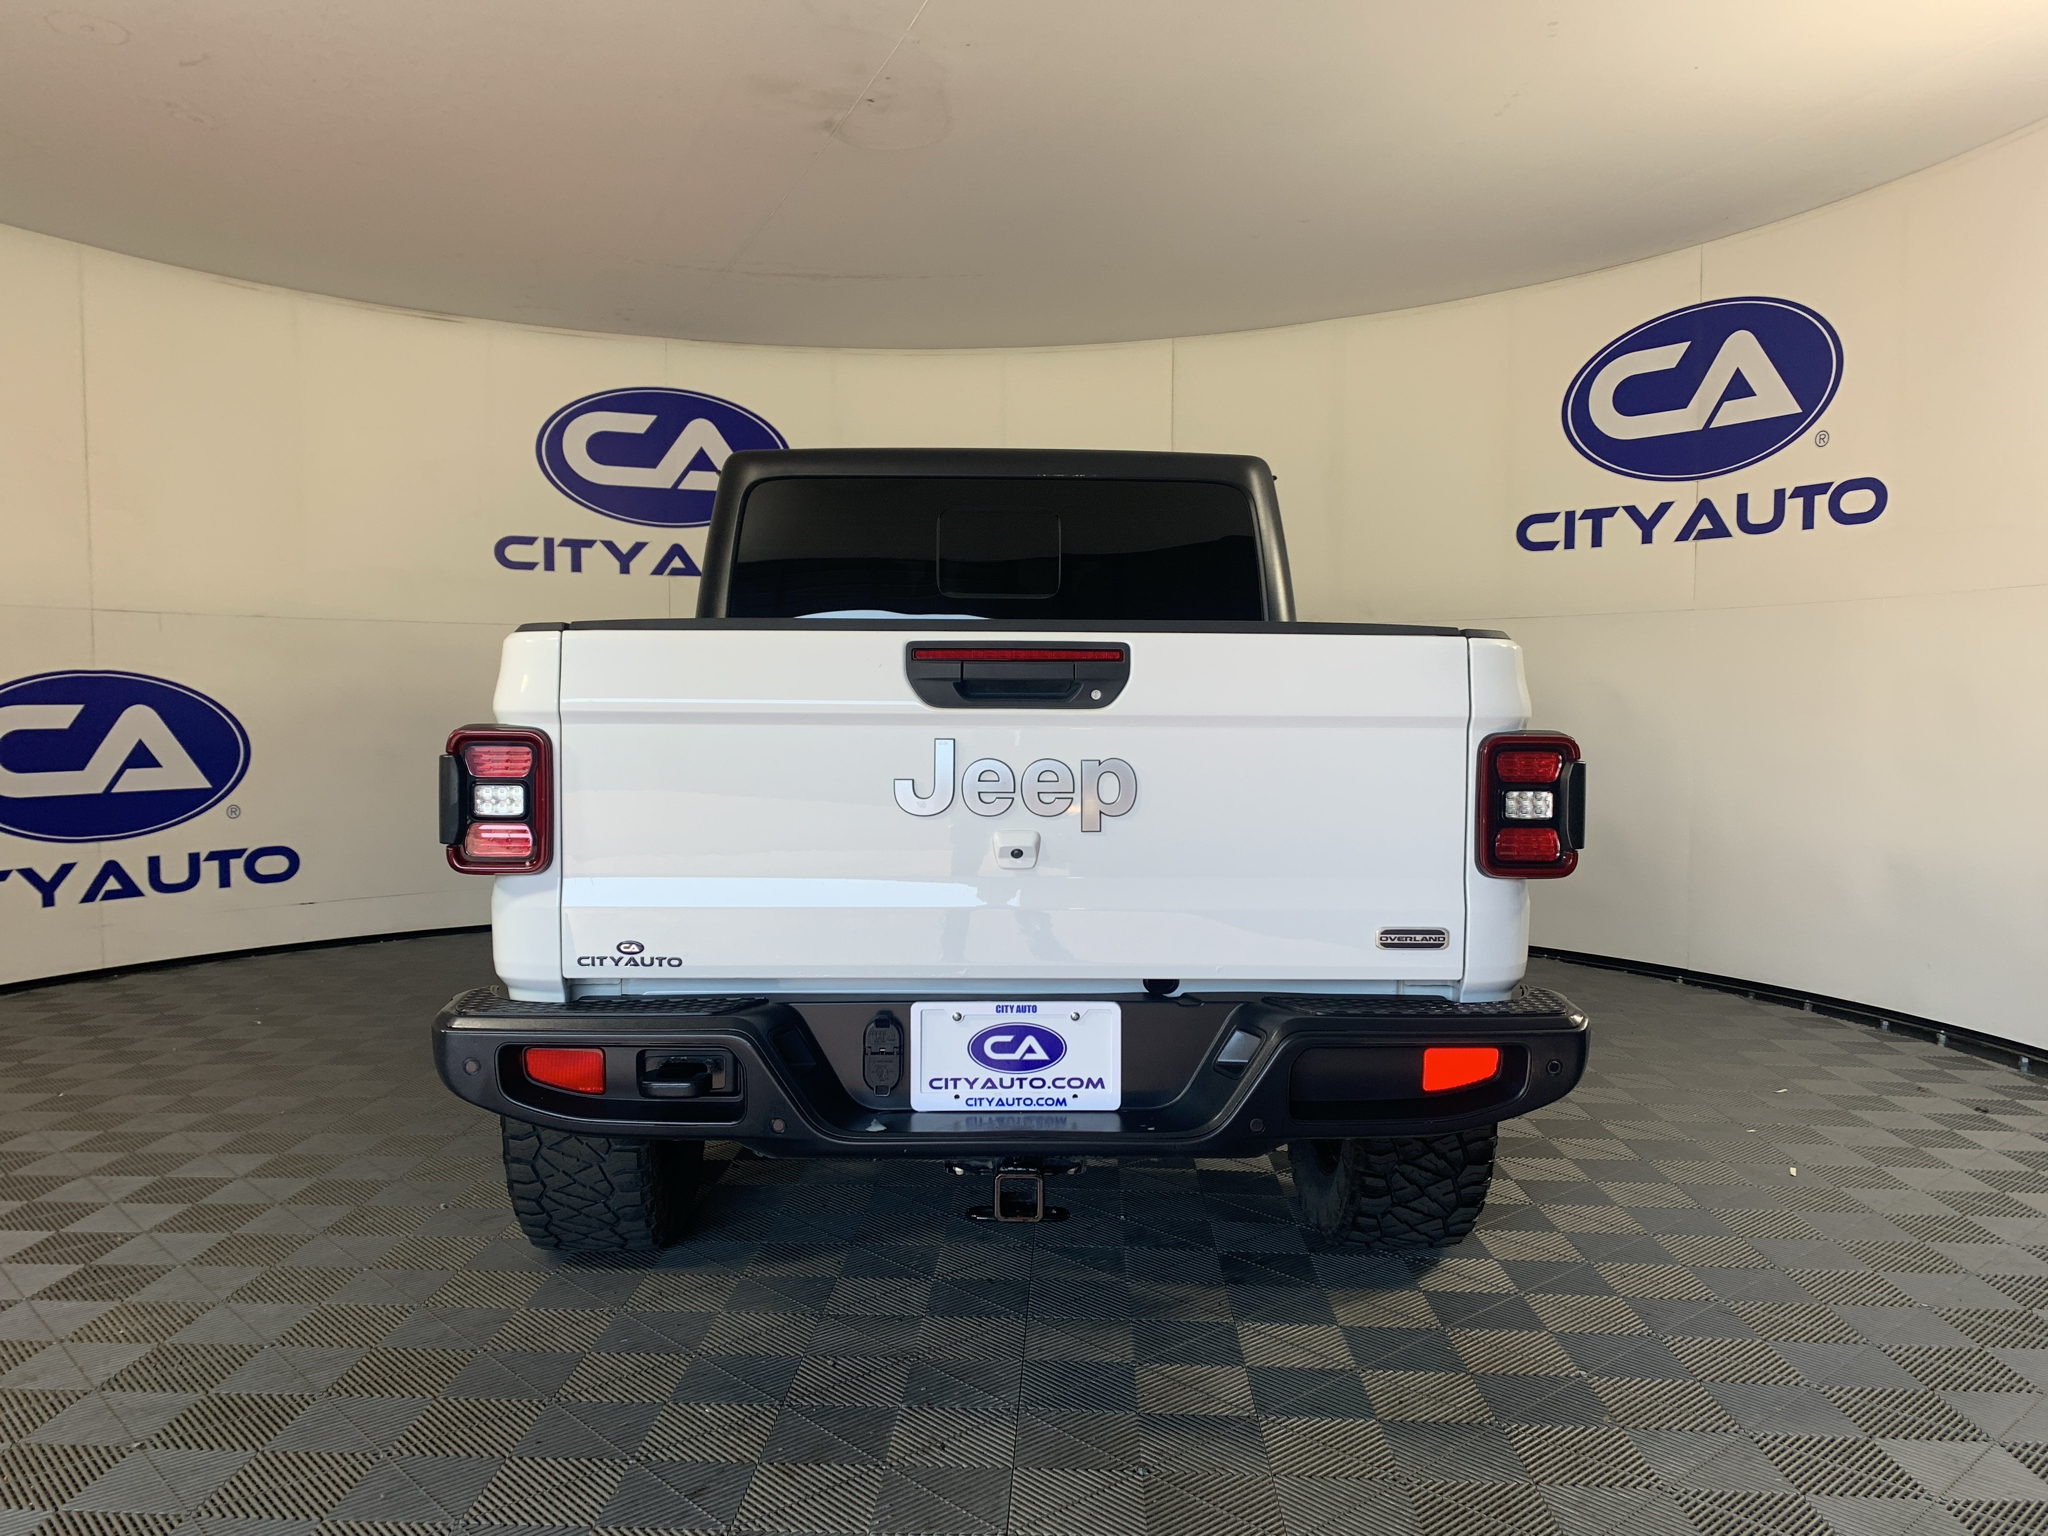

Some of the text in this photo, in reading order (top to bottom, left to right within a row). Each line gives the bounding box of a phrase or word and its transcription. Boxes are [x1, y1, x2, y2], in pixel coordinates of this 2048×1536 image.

[893, 738, 1138, 832] Jeep
[995, 1004, 1038, 1014] CITY AUTO
[929, 1077, 1106, 1090] CITYAUTO.COM
[965, 1097, 1068, 1107] CITYAUTO.COM
